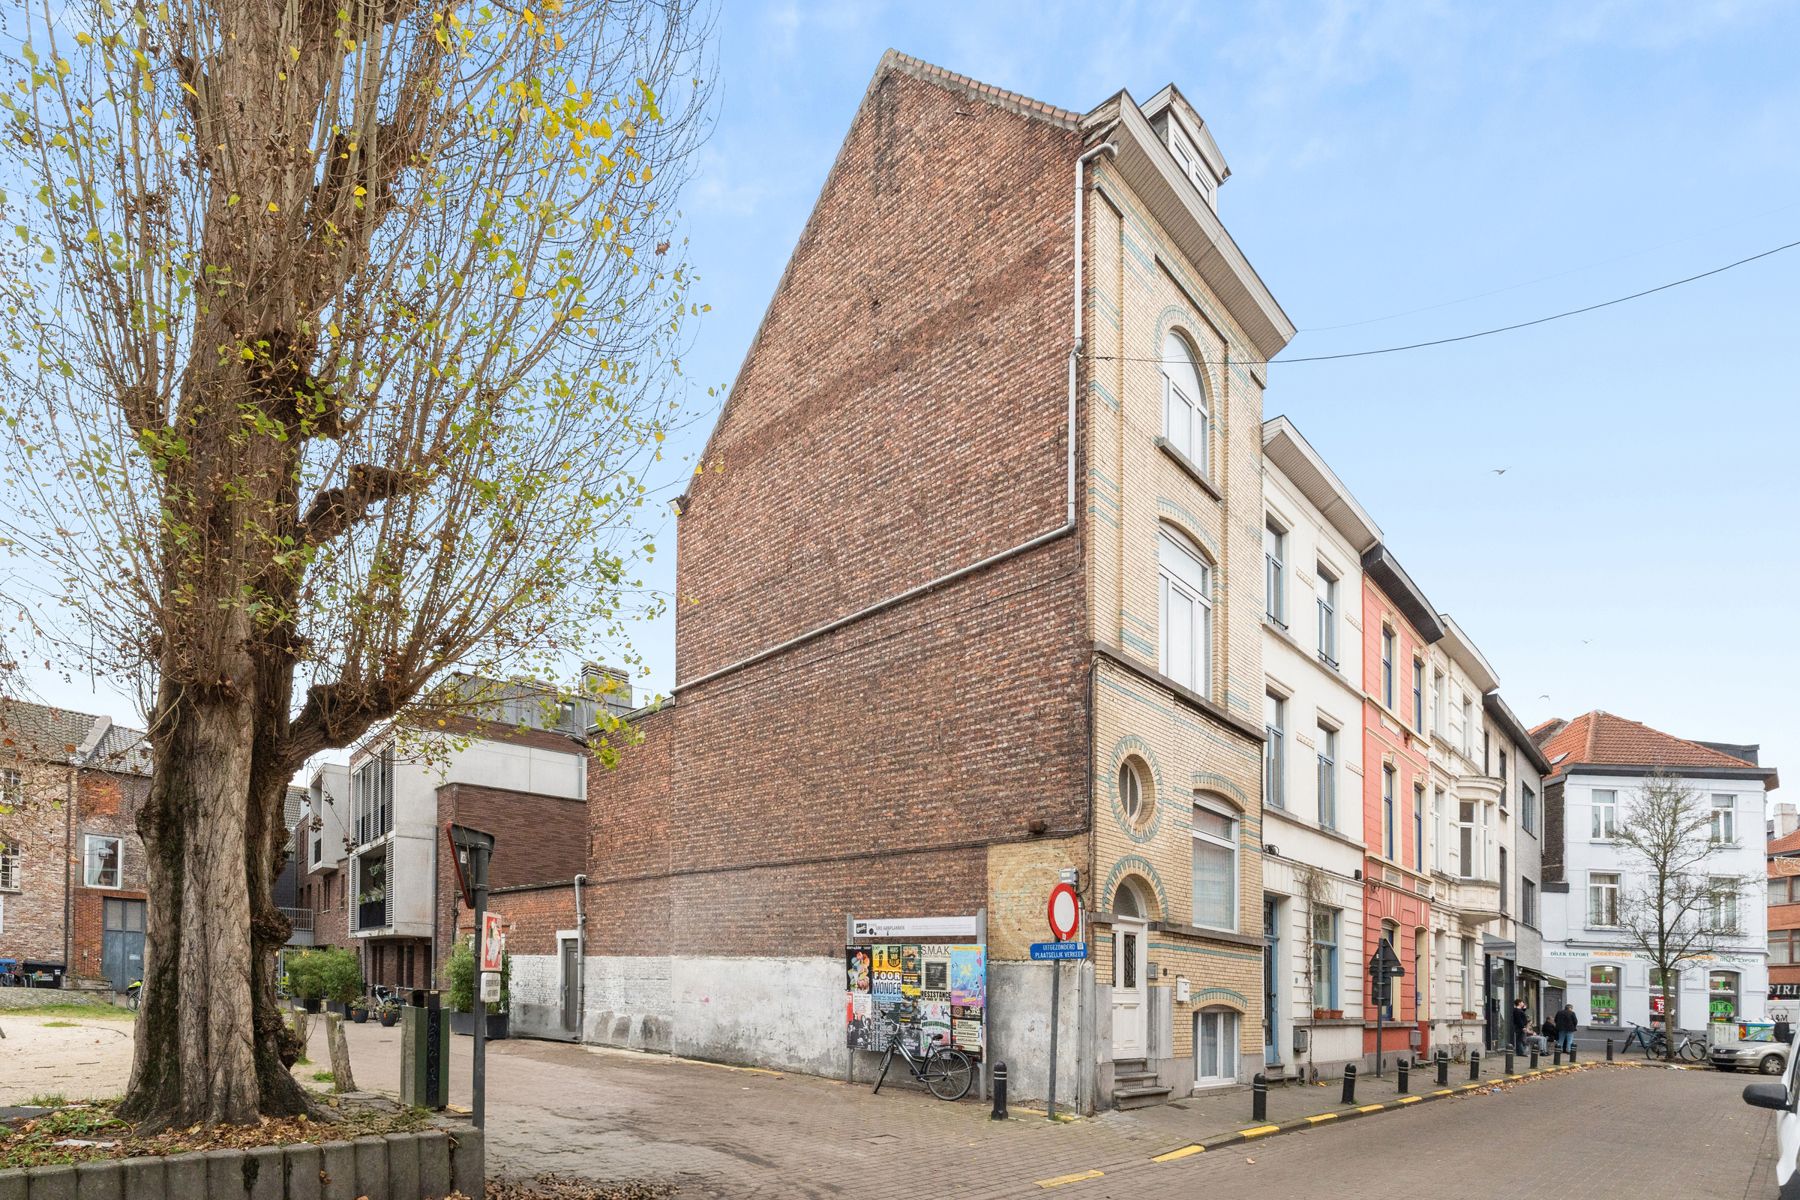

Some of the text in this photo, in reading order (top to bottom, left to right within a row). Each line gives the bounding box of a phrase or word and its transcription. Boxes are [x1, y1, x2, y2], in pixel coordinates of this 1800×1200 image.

[873, 971, 900, 980] FOOR
[873, 981, 901, 994] WONDER
[1768, 984, 1800, 995] FIRI
[921, 990, 952, 998] RESISTANCE
